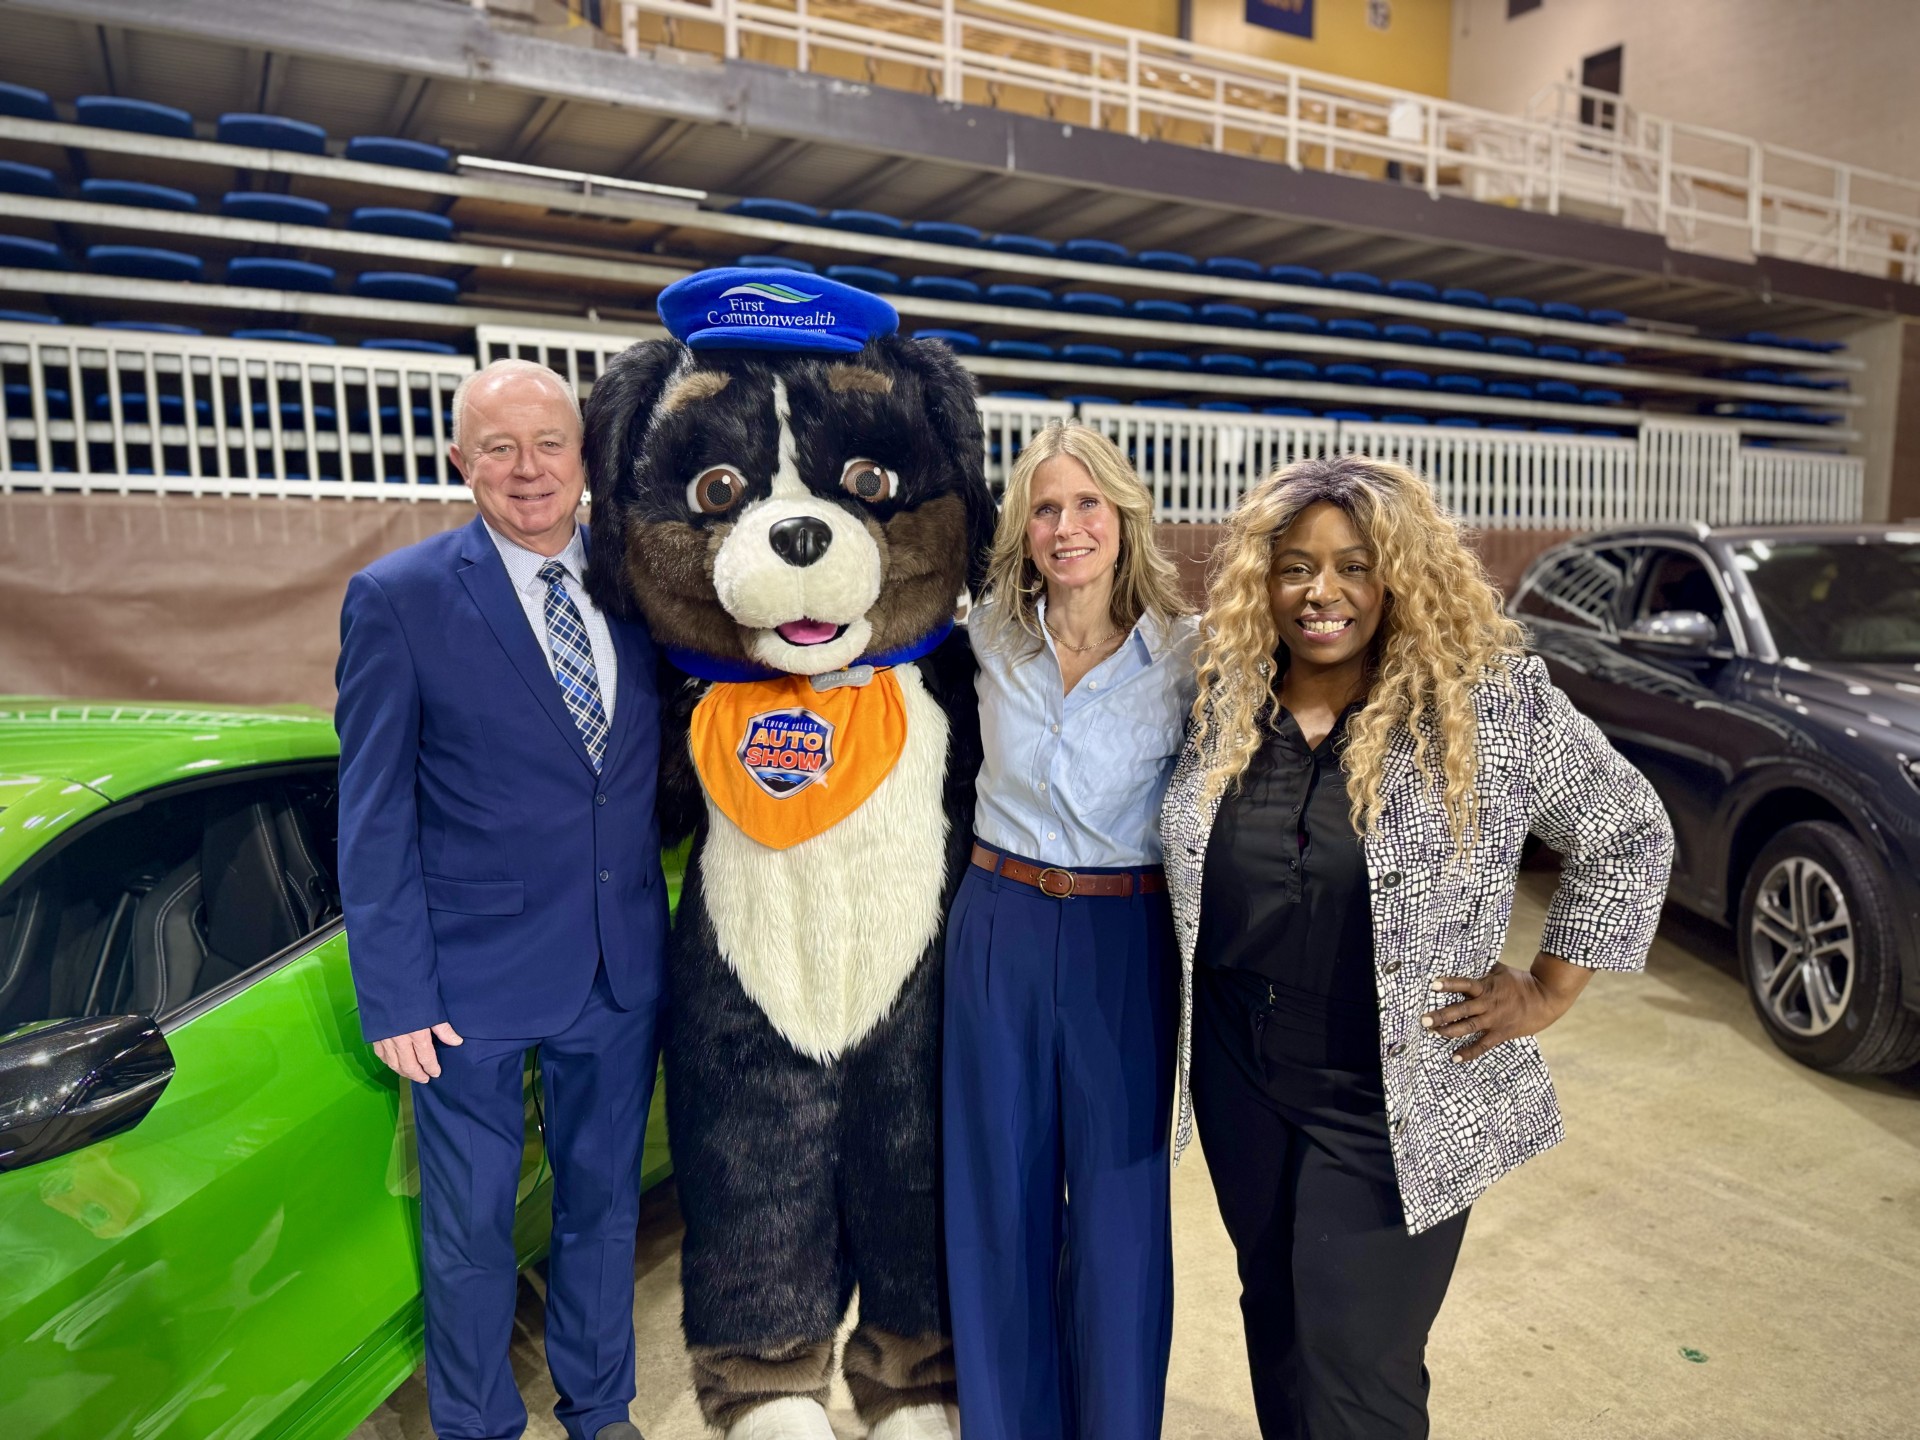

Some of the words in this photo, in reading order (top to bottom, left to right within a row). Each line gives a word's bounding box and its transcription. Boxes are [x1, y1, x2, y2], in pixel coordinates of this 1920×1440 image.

[729, 298, 765, 312] First
[707, 310, 836, 326] Commonwealth
[820, 671, 863, 683] DRIVER
[791, 722, 818, 732] VALLEY
[750, 728, 823, 751] AUTO
[745, 746, 823, 772] SHOW
